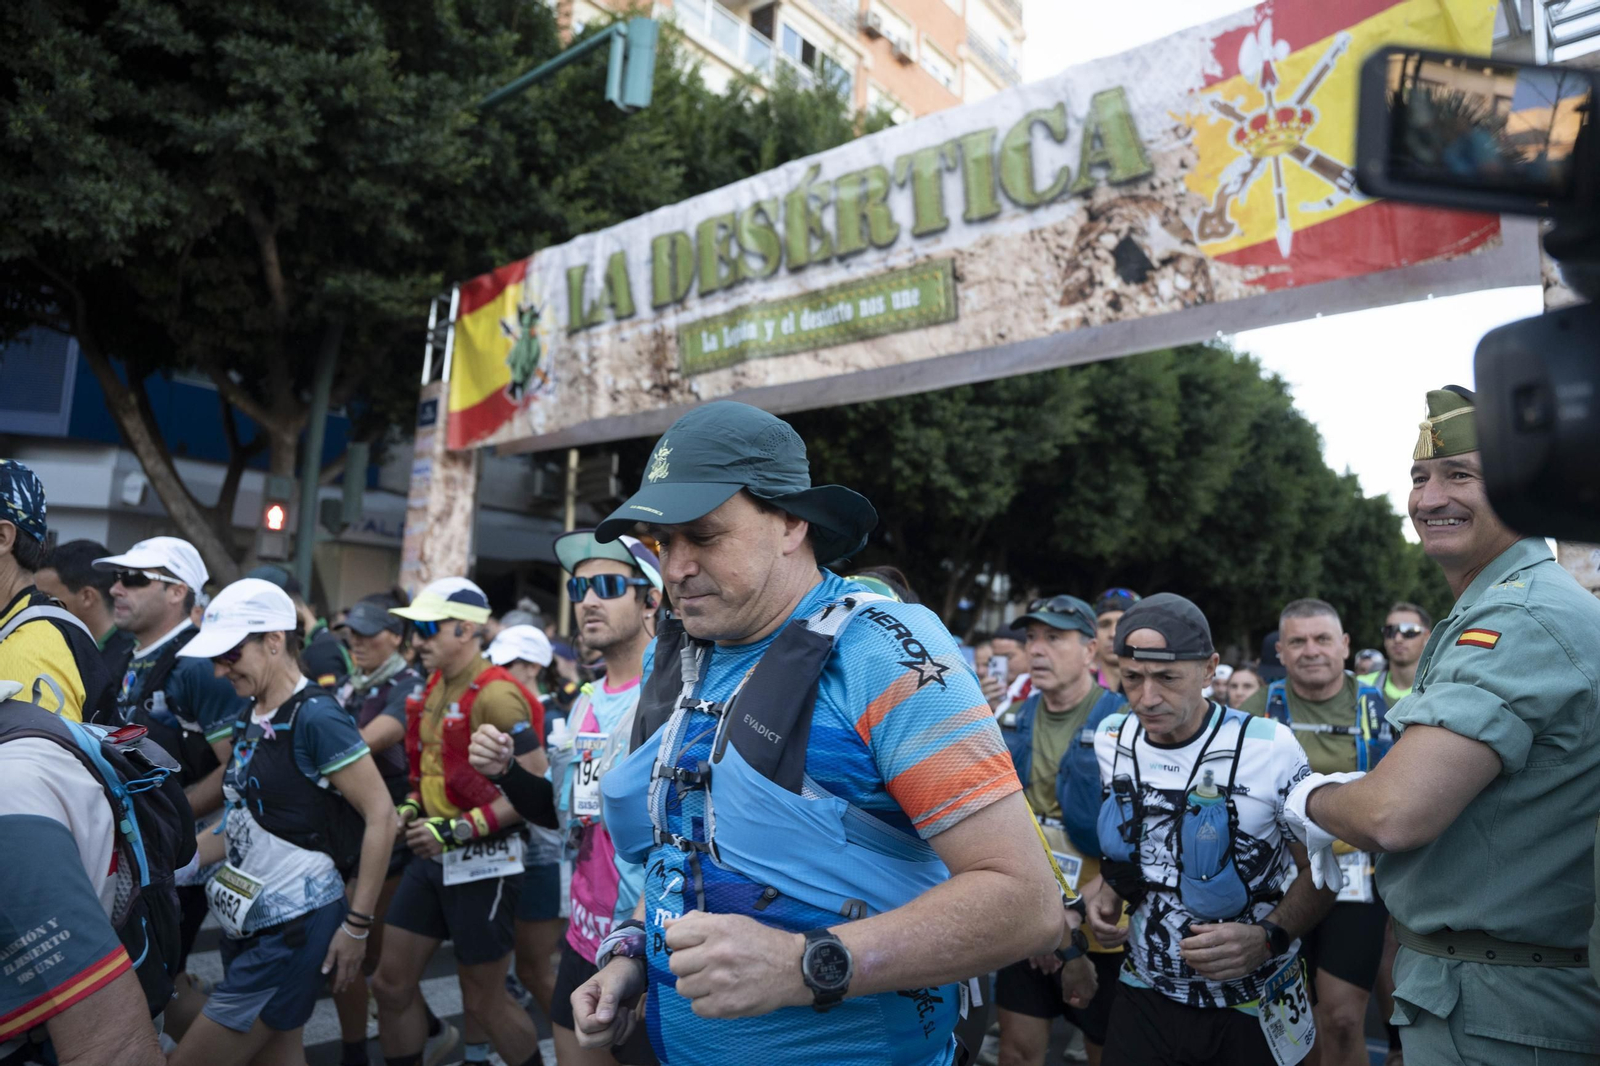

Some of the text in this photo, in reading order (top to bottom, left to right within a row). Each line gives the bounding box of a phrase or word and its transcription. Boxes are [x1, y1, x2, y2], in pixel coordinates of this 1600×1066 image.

[566, 84, 1153, 337] LA DESÉRTICA
[763, 319, 776, 342] y
[781, 311, 795, 335] el
[800, 300, 854, 331] desierto
[858, 294, 886, 318] nos
[891, 286, 920, 311] une
[857, 606, 928, 660] HERO
[743, 713, 782, 744] EVADICT
[47, 916, 59, 929] Y
[214, 887, 242, 925] 4652
[34, 950, 65, 975] UNE
